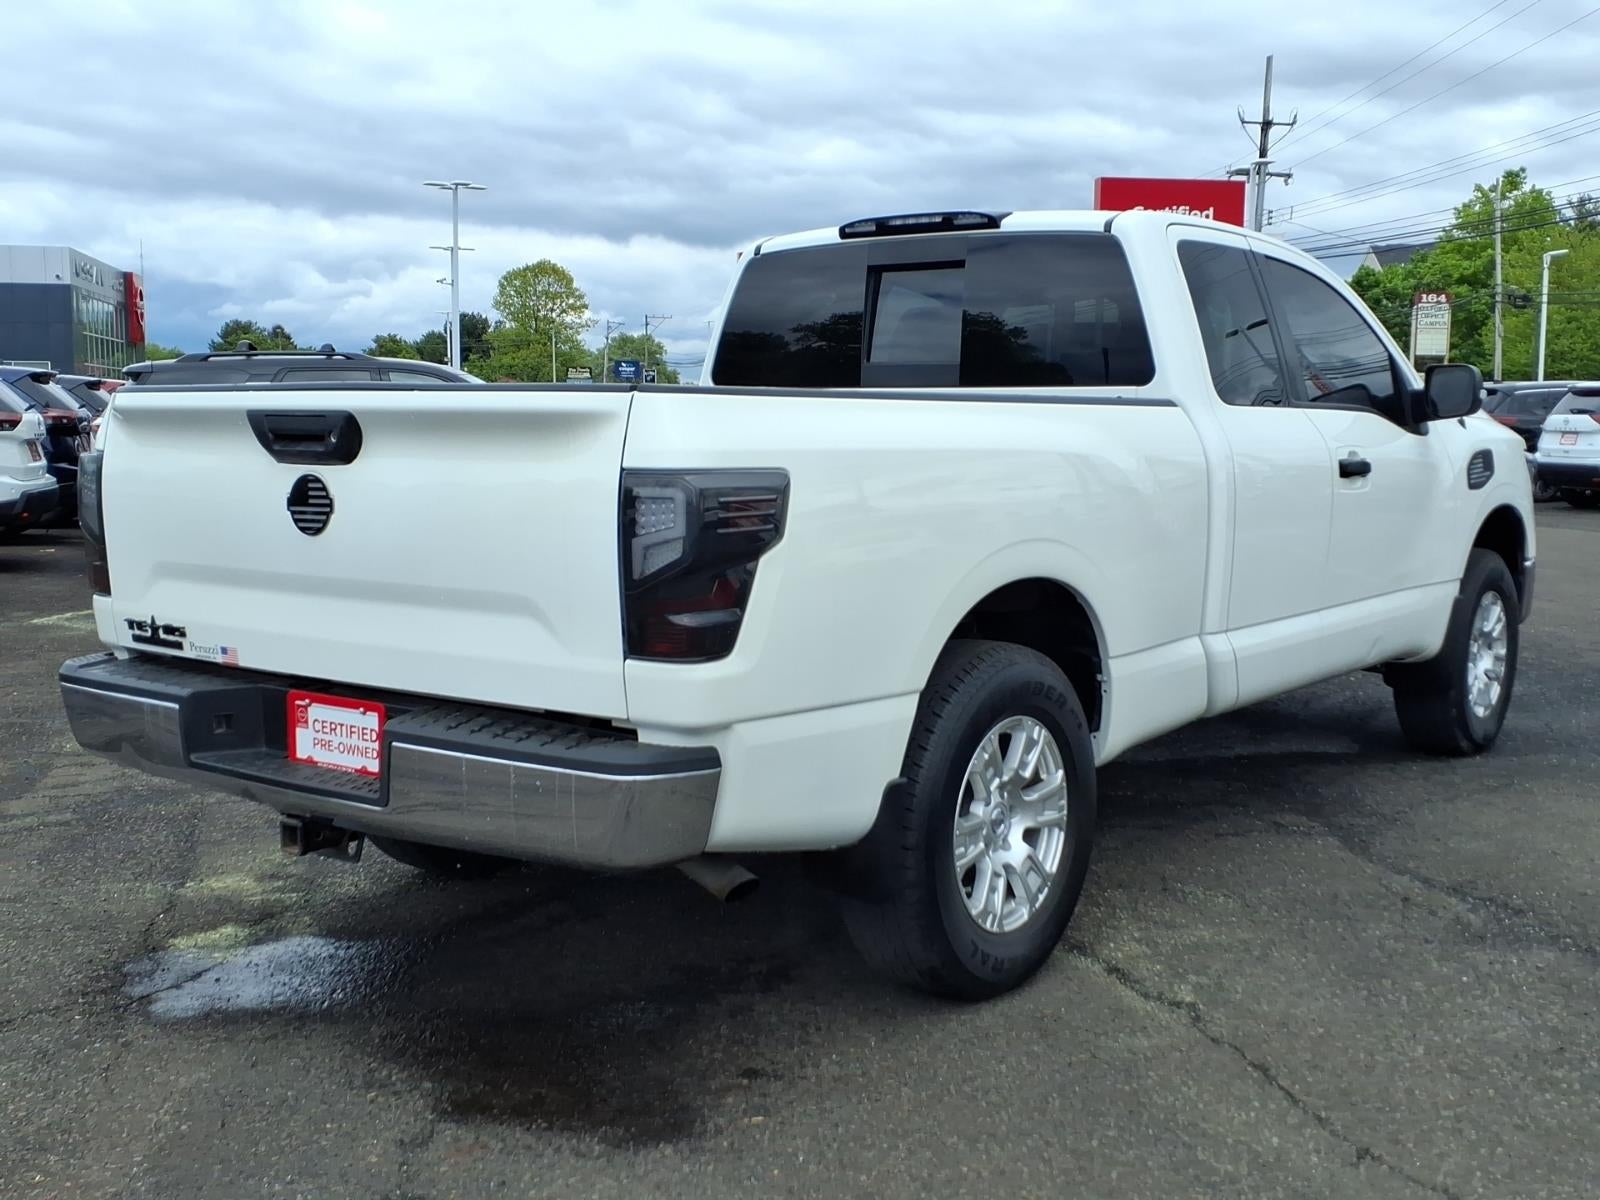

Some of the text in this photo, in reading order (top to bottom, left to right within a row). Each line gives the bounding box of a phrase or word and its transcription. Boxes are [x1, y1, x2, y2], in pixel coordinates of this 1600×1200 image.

[1420, 293, 1447, 303] 164
[1418, 319, 1447, 327] CAMPUS
[189, 640, 219, 656] Peruzzi
[312, 718, 379, 743] CERTIFIED
[312, 737, 379, 761] PRE-OWNED
